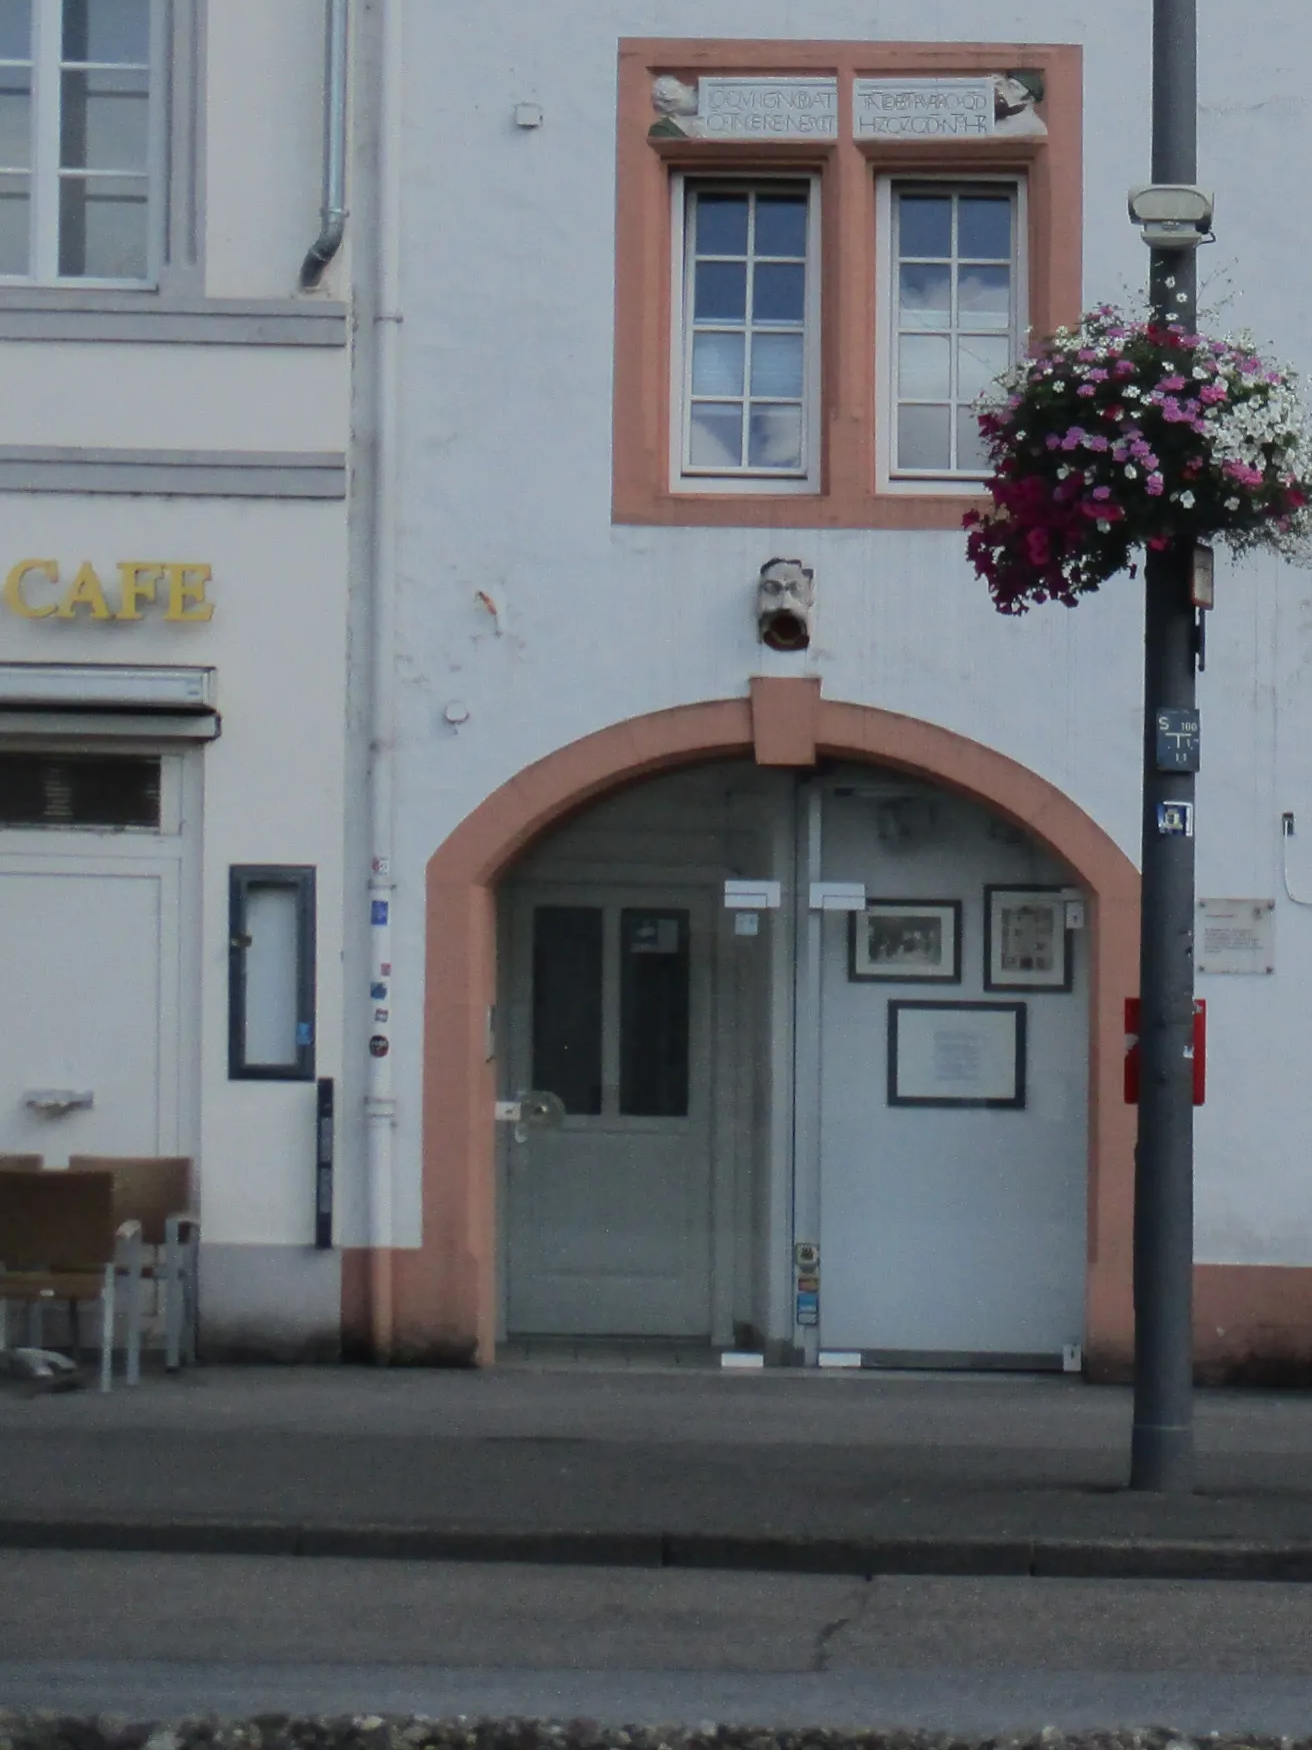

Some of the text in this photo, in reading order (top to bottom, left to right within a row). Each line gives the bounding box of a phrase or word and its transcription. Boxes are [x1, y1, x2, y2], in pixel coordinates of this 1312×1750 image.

[3, 556, 215, 623] CAFE
[1158, 716, 1198, 732] S 100
